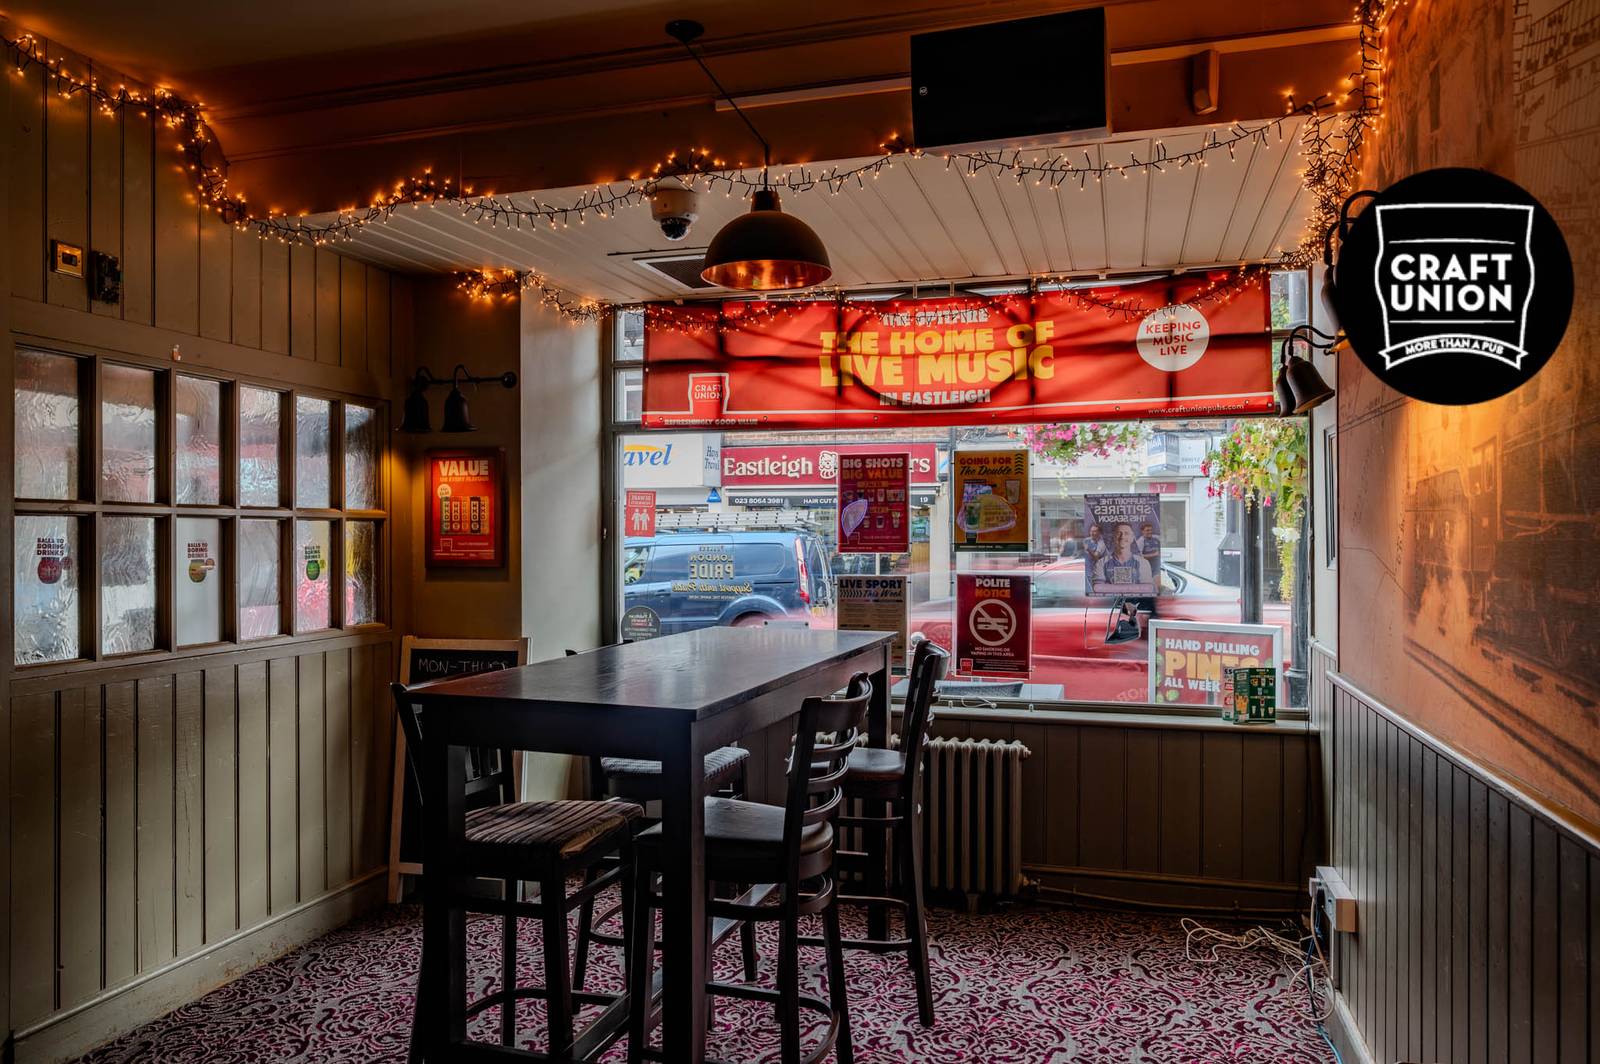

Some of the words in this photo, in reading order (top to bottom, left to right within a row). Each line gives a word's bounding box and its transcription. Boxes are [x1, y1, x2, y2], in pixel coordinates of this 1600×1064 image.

[1146, 321, 1201, 334] KEEPING
[819, 331, 880, 354] THE
[890, 328, 995, 355] HOME
[1006, 320, 1055, 347] OF
[1152, 332, 1195, 346] MUSIC
[1160, 345, 1188, 356] LIVE
[819, 354, 904, 387] LIVE
[918, 344, 1055, 386] MUSIC
[694, 384, 723, 392] CRAFT
[694, 391, 723, 400] UNION
[880, 392, 897, 406] IN
[902, 388, 991, 406] EASTLEIGH
[1148, 403, 1245, 415] www.craftunionpubs.com
[724, 454, 813, 478] Eastleigh
[842, 458, 863, 469] BIG
[865, 457, 904, 468] SHOTS
[960, 457, 990, 465] GOING
[992, 456, 1012, 465] FOR
[439, 460, 489, 477] VALUE
[843, 469, 864, 480] BIG
[867, 468, 904, 479] VALUE
[959, 465, 976, 476] The
[978, 465, 1012, 476] Double
[839, 579, 863, 589] LIVE
[865, 579, 903, 589] SPORT
[975, 578, 1011, 588] POLITE
[864, 588, 879, 598] This
[880, 588, 902, 597] Week
[975, 588, 1011, 598] NOTICE
[1165, 638, 1201, 651] HAND
[1205, 639, 1260, 656] PULLING
[1164, 676, 1184, 688] ALL
[1188, 678, 1221, 692] WEEK
